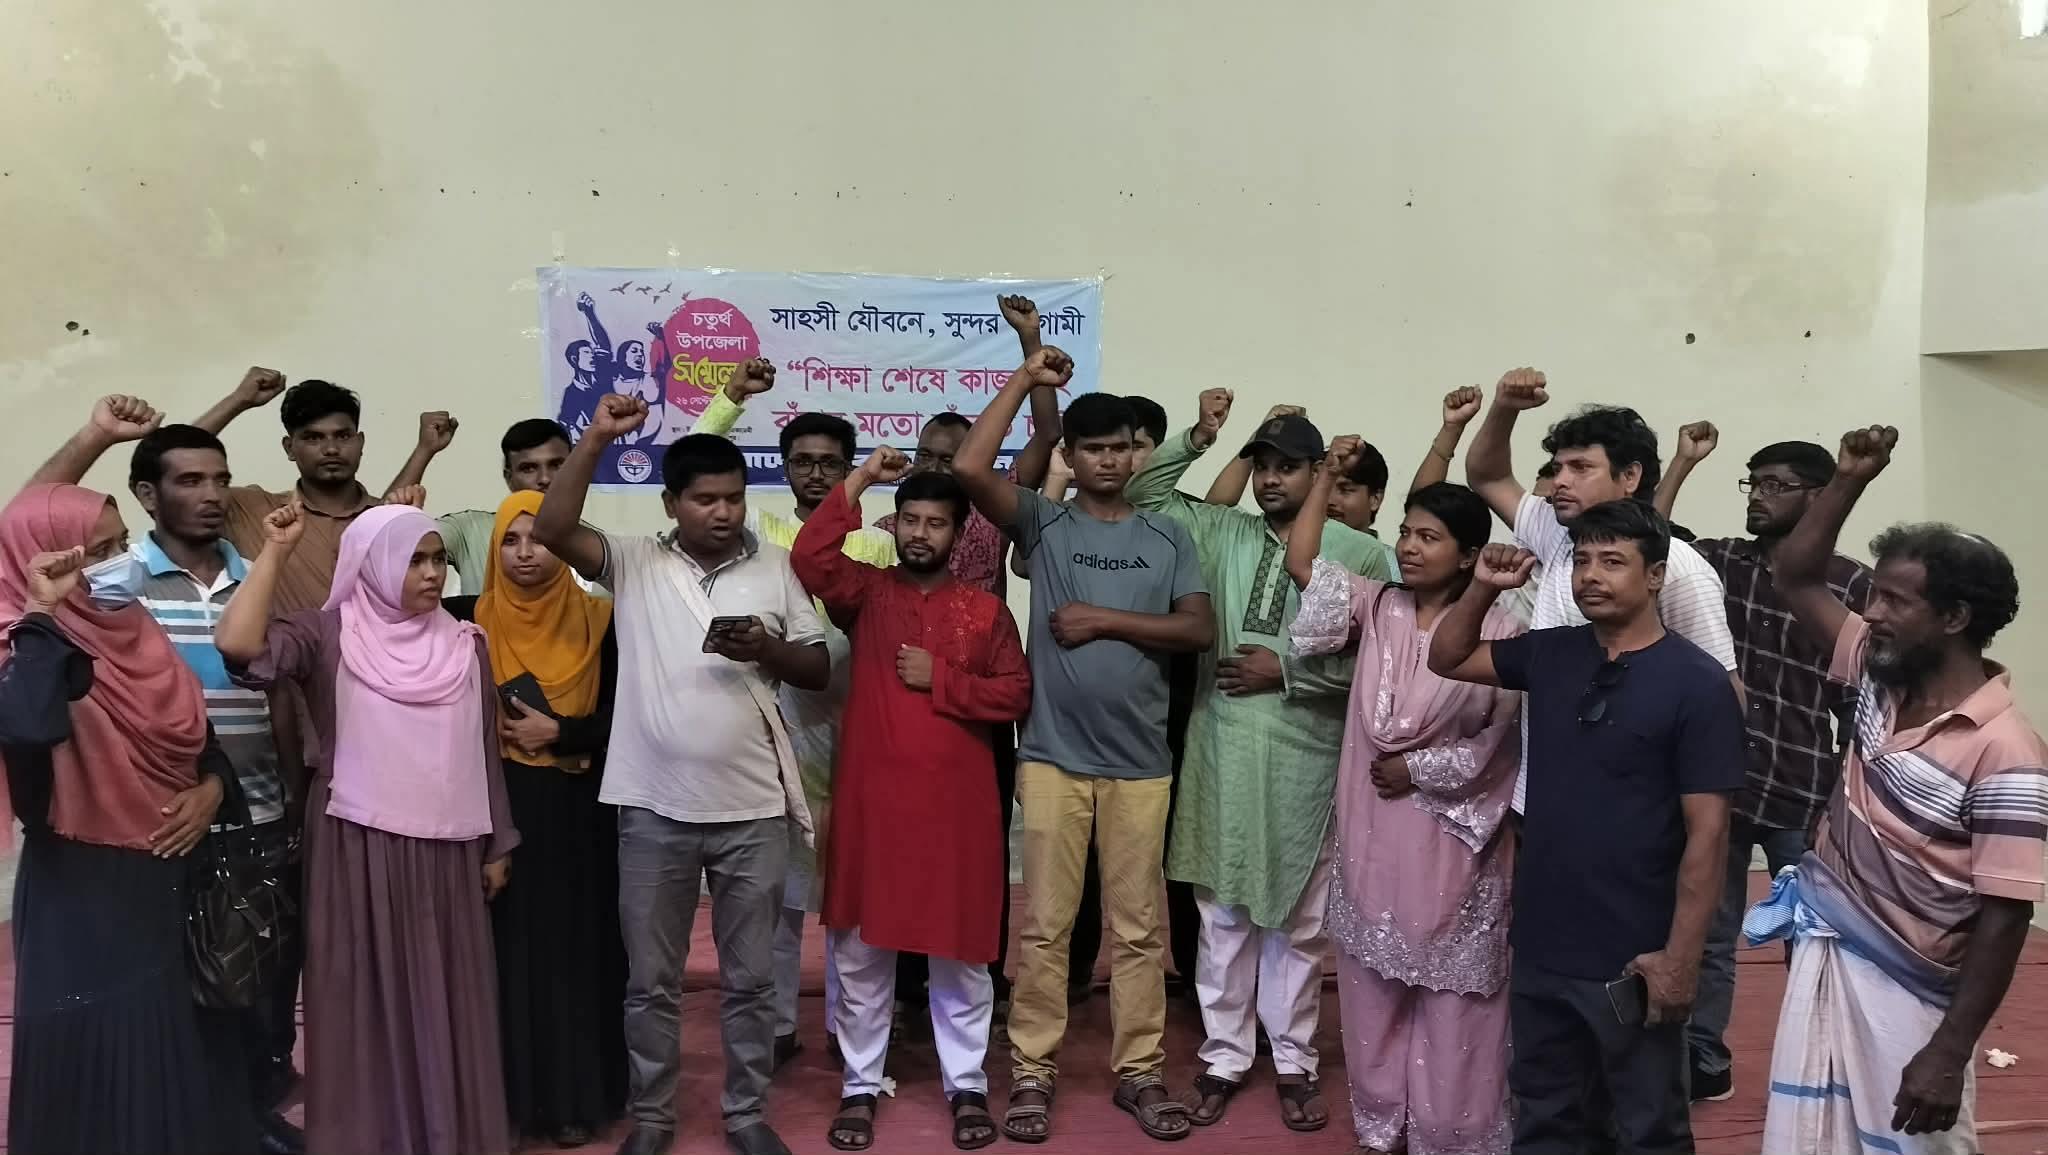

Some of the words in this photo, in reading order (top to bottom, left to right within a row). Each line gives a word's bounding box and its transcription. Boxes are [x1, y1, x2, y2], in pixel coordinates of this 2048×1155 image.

[690, 307, 734, 332] চতুর্থ
[769, 300, 841, 332] সাহসী
[847, 301, 936, 339] যৌবনে,
[942, 311, 1002, 340] সুন্দর
[675, 330, 749, 351] উপজেলা
[671, 353, 741, 395] সম্মেল
[787, 356, 873, 393] “শিক্ষা
[881, 366, 949, 395] শেষে
[854, 409, 925, 439] মতো
[1072, 552, 1129, 571] adidas
